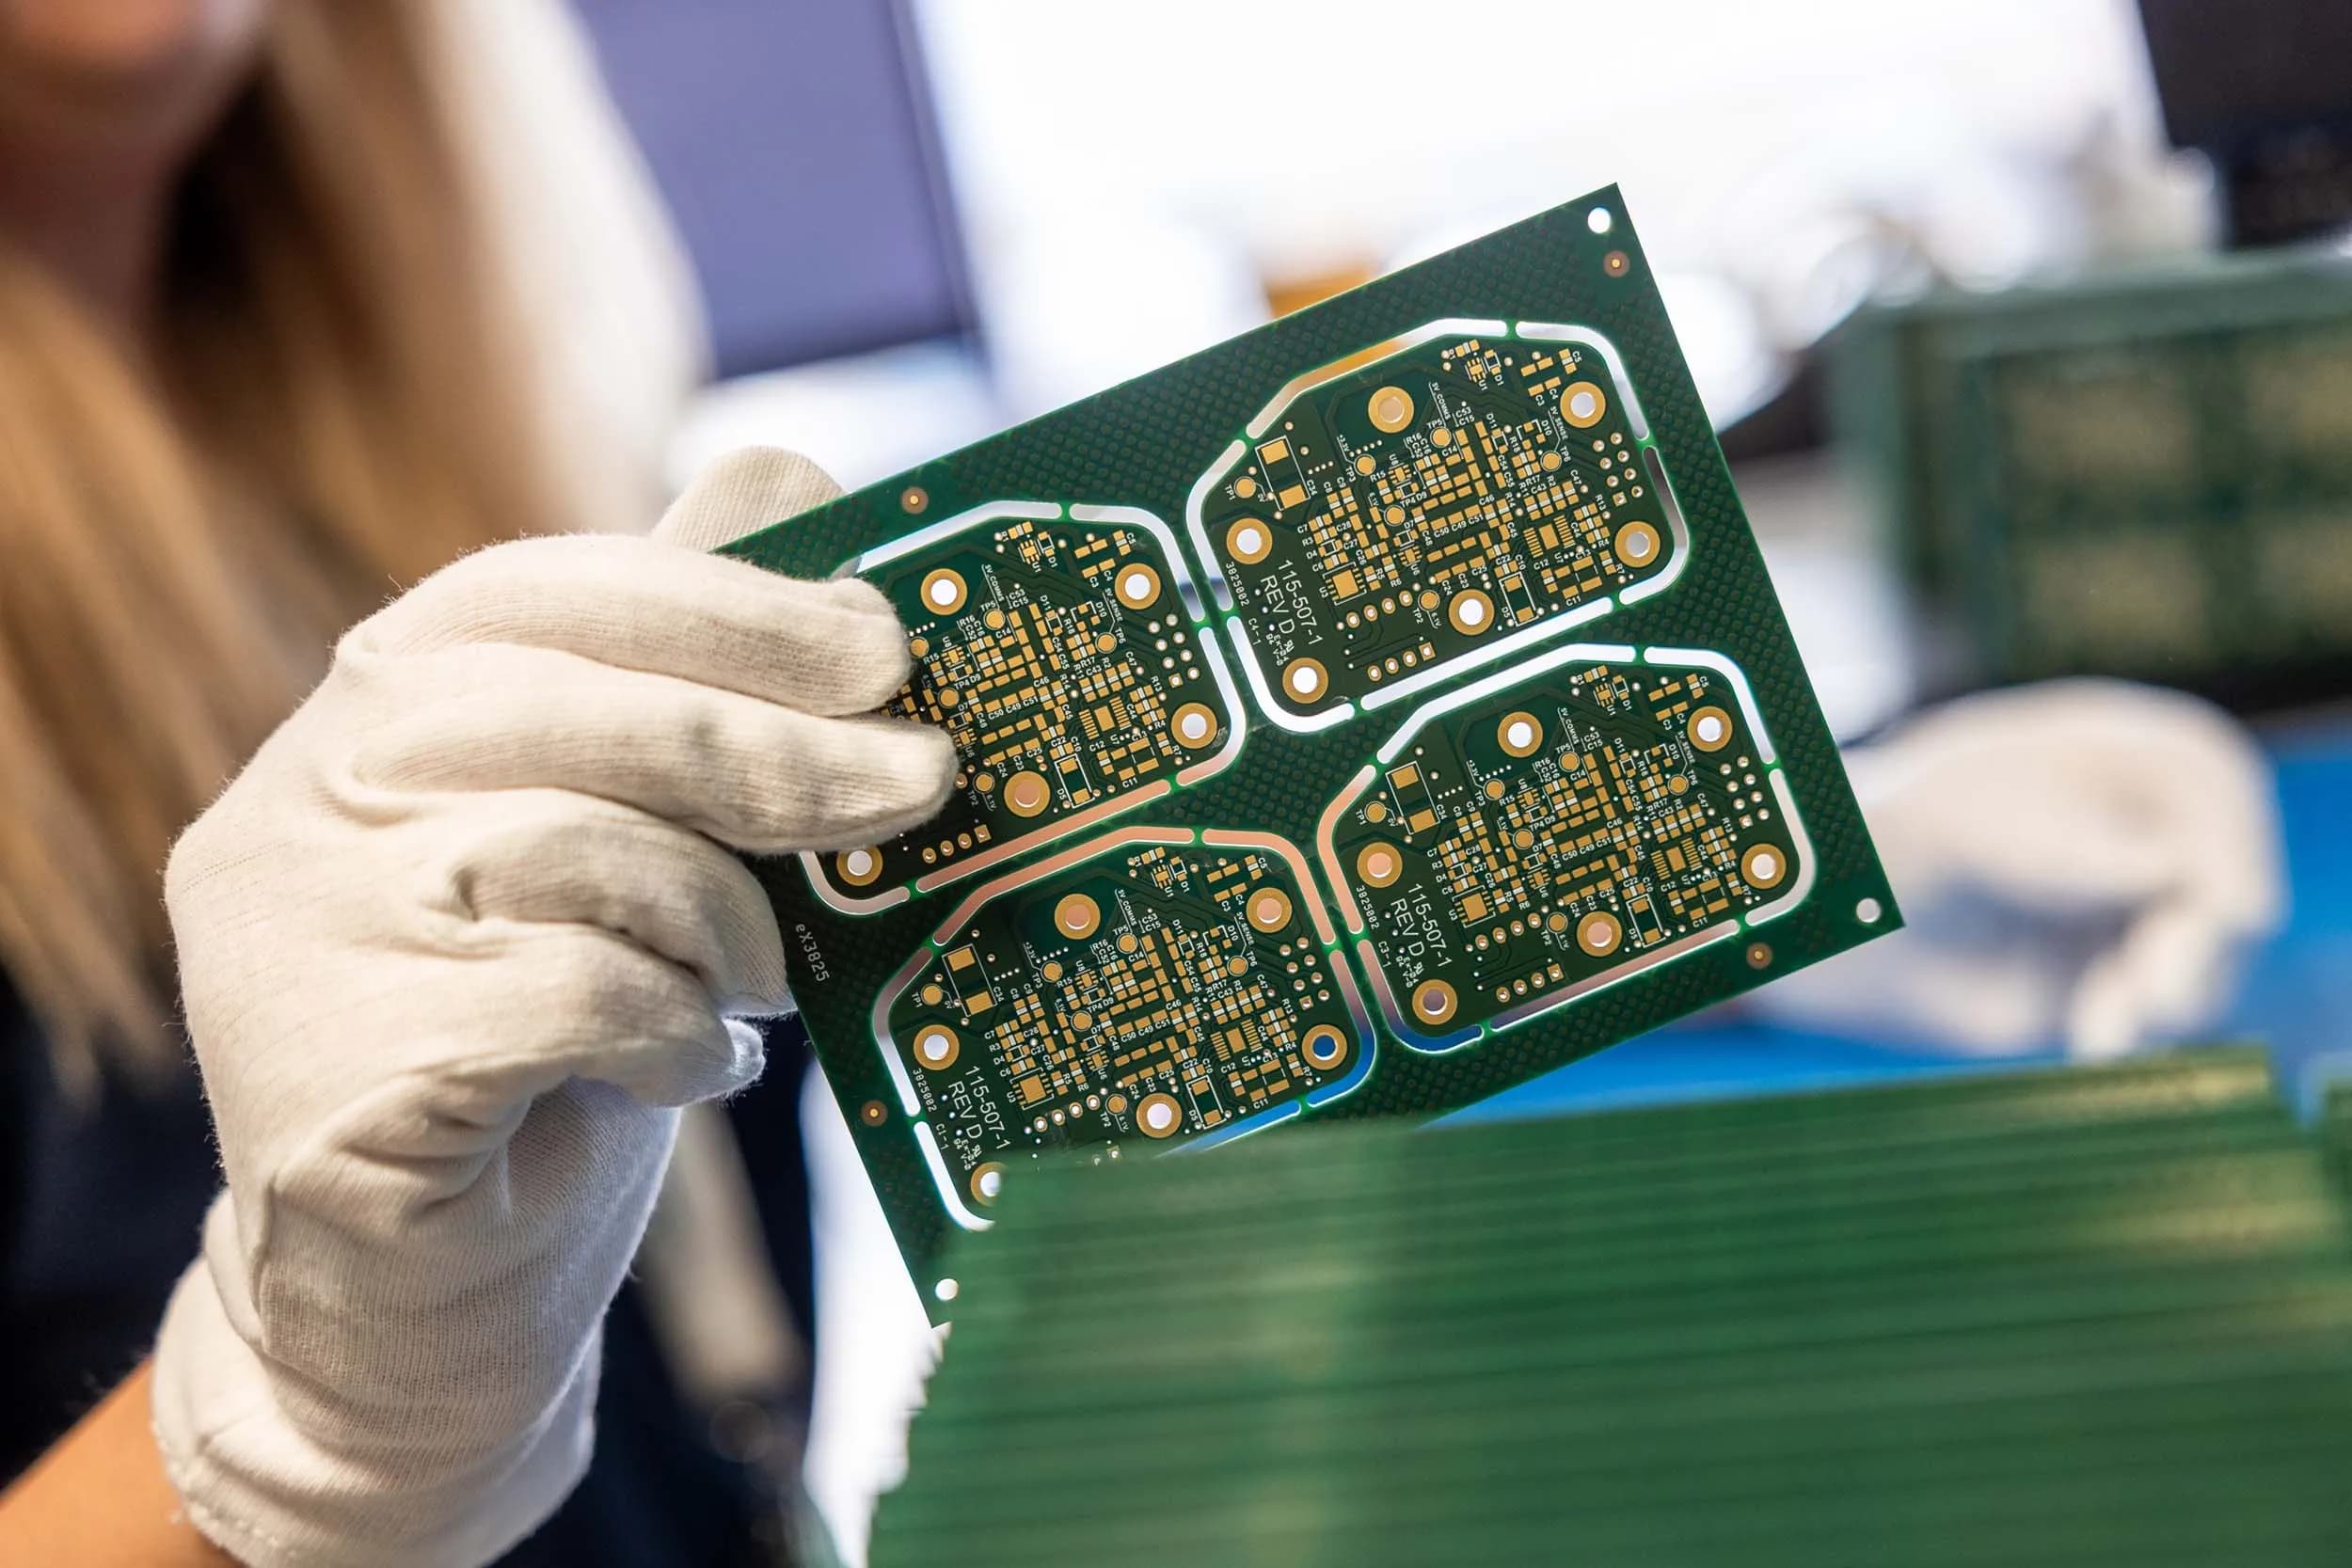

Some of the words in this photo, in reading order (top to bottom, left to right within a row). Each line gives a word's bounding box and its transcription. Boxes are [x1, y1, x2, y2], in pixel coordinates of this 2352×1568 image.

[1478, 379, 1487, 390] U1
[1494, 374, 1503, 386] D1
[1426, 418, 1442, 429] TP5
[1458, 414, 1474, 425] C15
[1486, 413, 1497, 428] D11
[1541, 420, 1552, 436] D10
[1406, 432, 1422, 444] R16
[1420, 437, 1432, 454] C16
[1441, 445, 1457, 456] C14
[1560, 445, 1571, 462] TP6
[1345, 466, 1356, 482] TP3
[1370, 470, 1386, 482] R15
[1525, 474, 1540, 486] R17
[1225, 484, 1235, 500] TP1
[1306, 479, 1317, 496] C34
[1518, 482, 1530, 497] R11
[1399, 497, 1416, 508] TP4
[1504, 492, 1516, 508] R14
[1296, 524, 1308, 533] C7
[1404, 519, 1414, 529] D7
[1507, 522, 1518, 538] C45
[1433, 526, 1450, 538] C50
[1301, 536, 1313, 546] R3
[1597, 538, 1610, 547] R4
[1306, 549, 1317, 559] D4
[1495, 554, 1511, 565] C22
[1032, 561, 1041, 572] U1
[1048, 556, 1057, 567] D1
[1515, 554, 1526, 570] C10
[1534, 558, 1549, 570] C12
[1375, 567, 1385, 579] R5
[1410, 563, 1420, 576] U6
[1615, 562, 1625, 574] R7
[1441, 579, 1453, 595] C24
[980, 600, 996, 611] TP5
[1012, 596, 1028, 608] C15
[1040, 594, 1051, 610] D11
[1260, 575, 1289, 612] REV
[1278, 618, 1295, 634] D
[1279, 560, 1323, 644] 115-507-1
[1565, 594, 1581, 606] C11
[1095, 601, 1107, 617] D10
[959, 614, 975, 626] R16
[1413, 607, 1423, 624] TP2
[973, 620, 985, 637] C16
[995, 626, 1011, 639] C14
[1115, 626, 1126, 643] TP6
[923, 653, 940, 664] R15
[1080, 656, 1095, 668] R17
[1073, 663, 1085, 679] R11
[953, 679, 970, 690] TP4
[1059, 673, 1071, 689] R14
[988, 708, 1004, 720] C50
[1062, 704, 1073, 720] C45
[1154, 720, 1166, 729] R4
[1050, 736, 1066, 747] C22
[1071, 736, 1082, 752] C10
[1089, 740, 1105, 752] C12
[1172, 744, 1182, 754] R7
[996, 762, 1008, 778] C24
[1121, 777, 1137, 788] C11
[1165, 886, 1174, 897] U1
[1181, 880, 1189, 893] D1
[1112, 924, 1129, 935] TP5
[1145, 920, 1161, 931] C15
[1172, 919, 1184, 934] D11
[1391, 897, 1419, 935] REV
[1407, 941, 1424, 956] D
[1408, 883, 1452, 967] 115-507-1
[1227, 925, 1238, 941] D10
[1092, 939, 1108, 950] R16
[795, 924, 830, 982] eX3825
[1106, 944, 1118, 960] C16
[1128, 951, 1144, 962] C14
[1246, 950, 1258, 967] TP6
[1032, 972, 1042, 989] TP3
[1057, 976, 1073, 988] R15
[1212, 978, 1227, 990] R17
[912, 991, 923, 1007] TP1
[993, 986, 1005, 1002] C34
[1205, 986, 1216, 1002] R11
[1087, 1003, 1103, 1014] TP4
[1191, 996, 1203, 1012] R14
[984, 1030, 994, 1039] C7
[1090, 1024, 1101, 1034] D7
[1194, 1026, 1205, 1042] C45
[1120, 1031, 1136, 1042] C50
[1284, 1041, 1296, 1051] R4
[993, 1055, 1005, 1065] D4
[1183, 1058, 1199, 1069] C22
[1202, 1058, 1214, 1073] C10
[1220, 1062, 1236, 1073] C12
[1302, 1066, 1312, 1076] R7
[1062, 1072, 1073, 1085] R5
[1097, 1068, 1107, 1080] U6
[1129, 1084, 1140, 1100] C24
[947, 1081, 977, 1118] REV
[966, 1123, 982, 1138] D
[965, 1066, 1010, 1148] 115-507-1
[1253, 1098, 1268, 1109] C11
[1100, 1111, 1111, 1127] TP2
